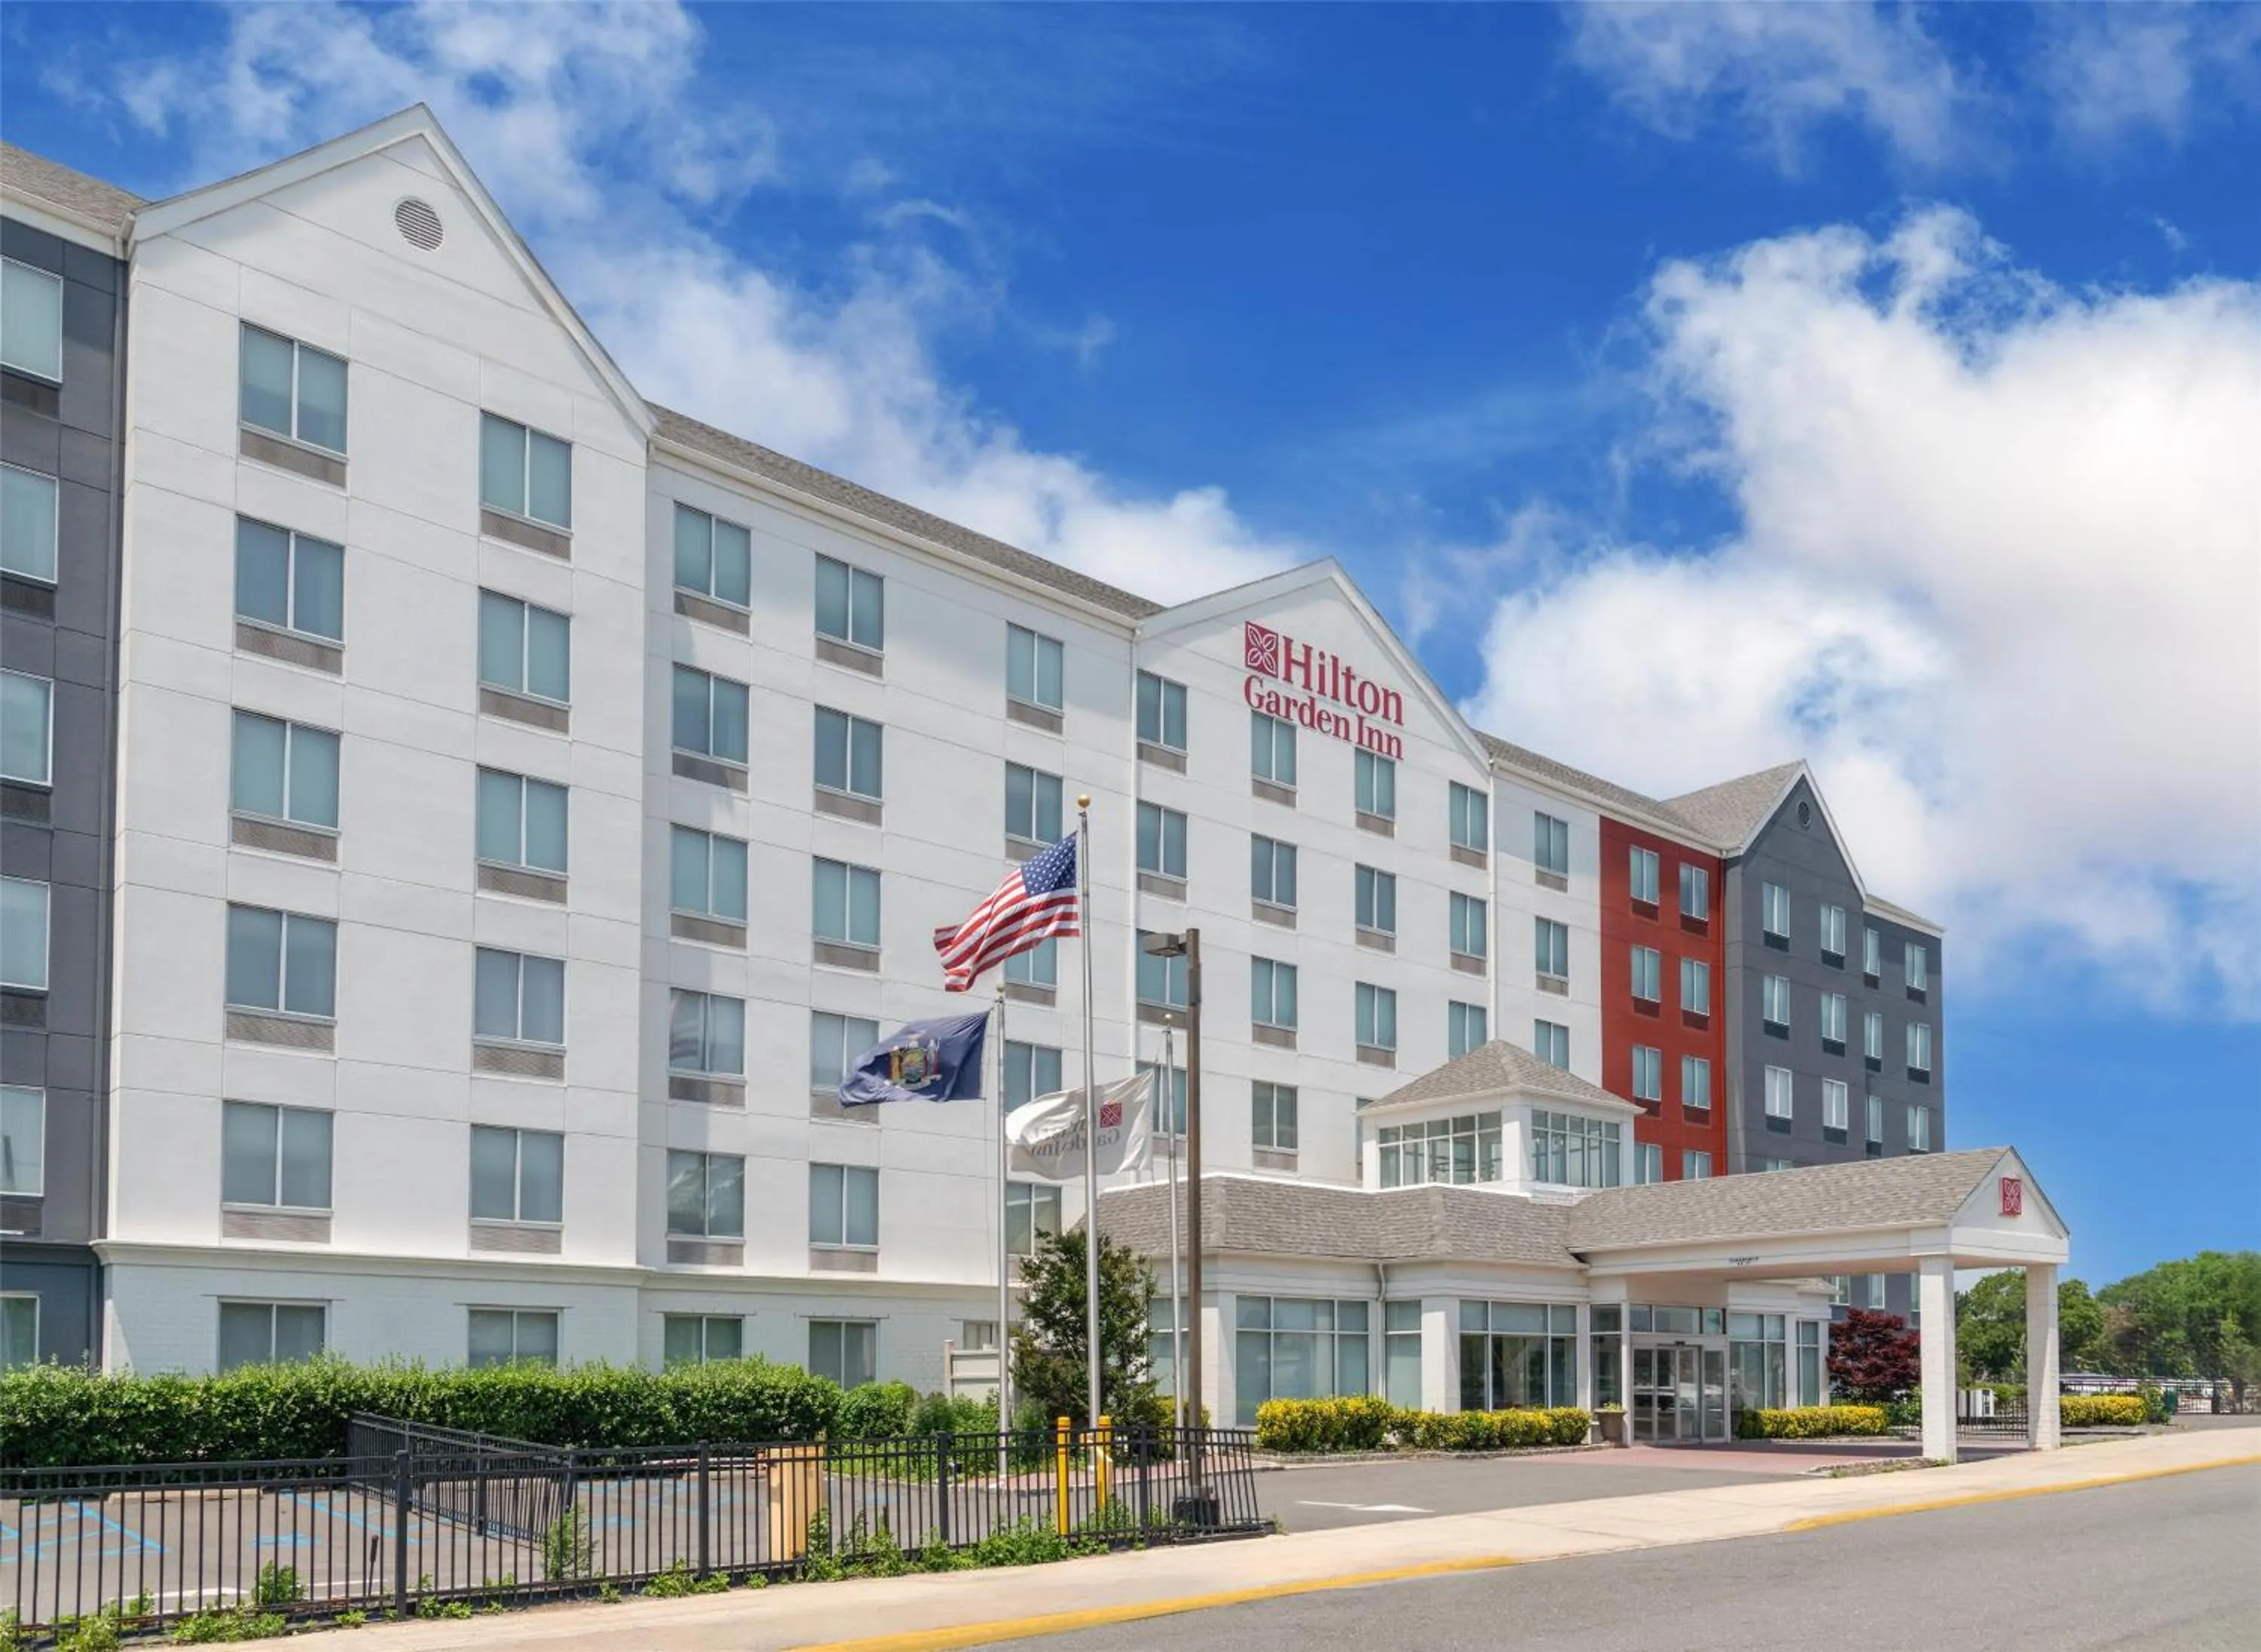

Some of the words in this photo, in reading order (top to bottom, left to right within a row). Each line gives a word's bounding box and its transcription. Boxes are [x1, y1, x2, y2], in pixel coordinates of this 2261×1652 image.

[1244, 675, 1351, 742] Garden
[1355, 714, 1403, 760] Inn
[1282, 635, 1403, 726] Hilton
